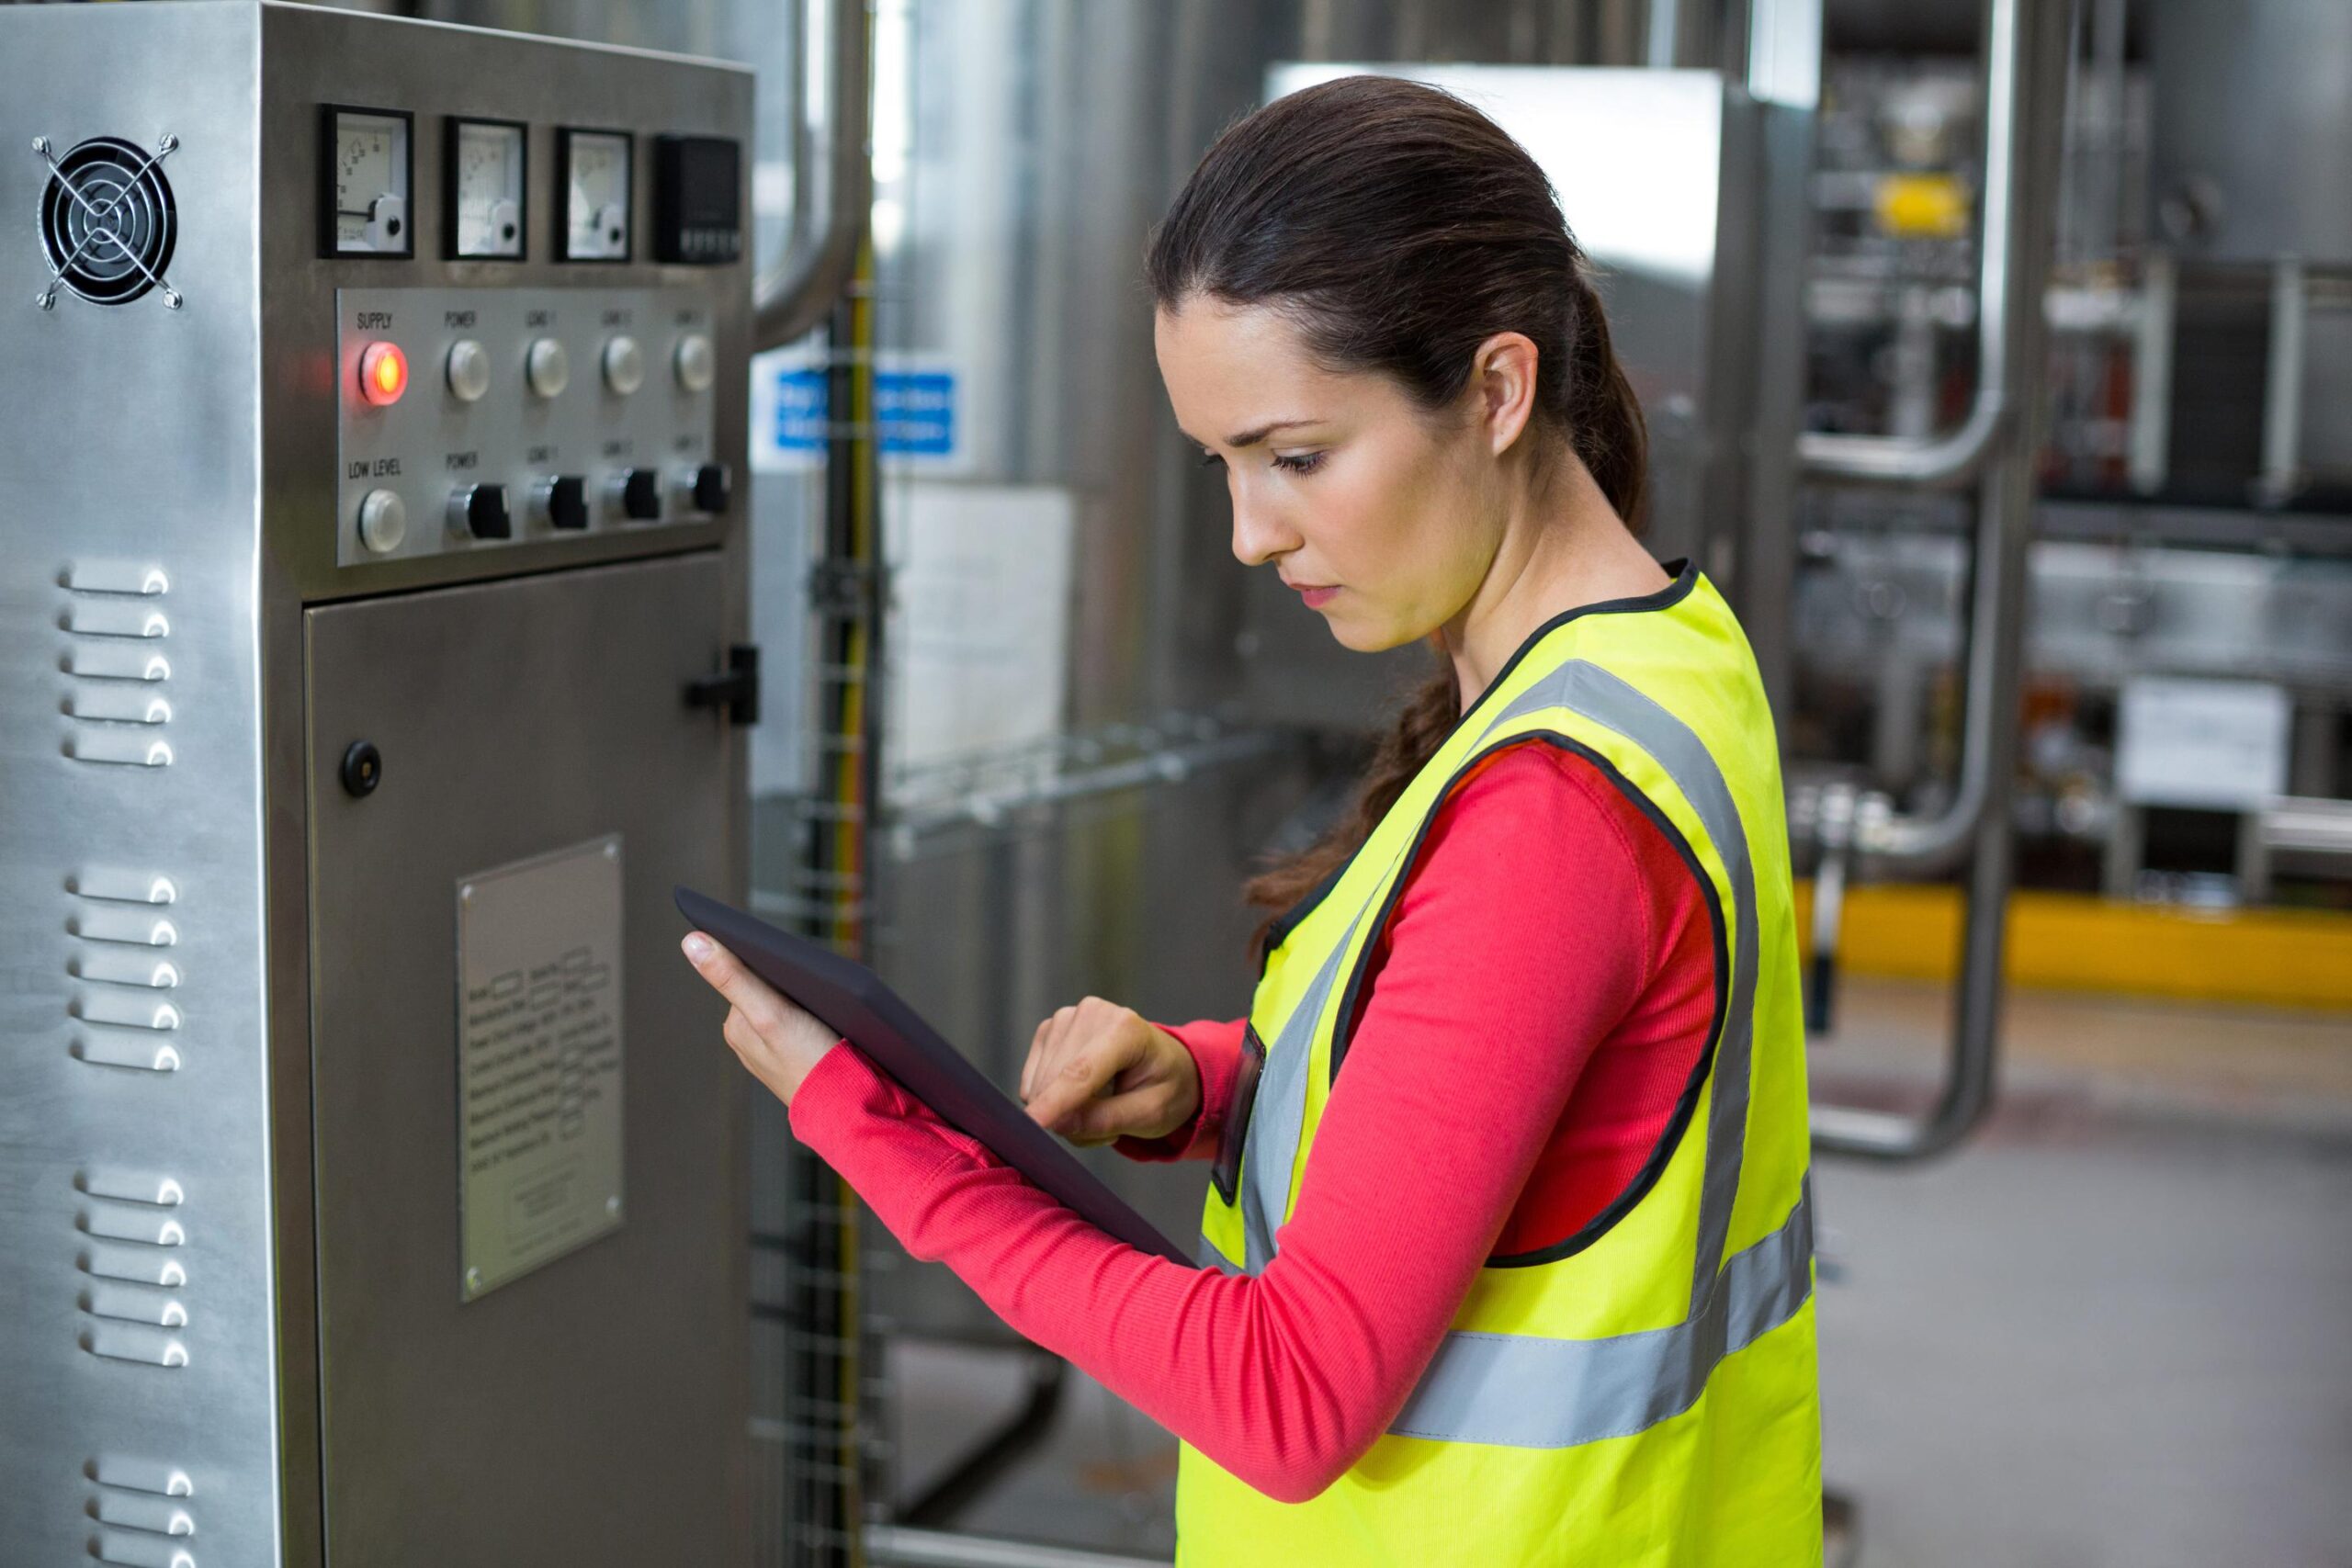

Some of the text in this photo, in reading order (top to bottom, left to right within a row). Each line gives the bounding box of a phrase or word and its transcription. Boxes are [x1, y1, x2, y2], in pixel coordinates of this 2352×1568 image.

[356, 312, 392, 330] SUPPLY
[444, 310, 476, 328] POWER
[348, 457, 401, 480] LOW LEVEL
[447, 452, 477, 470] POWER
